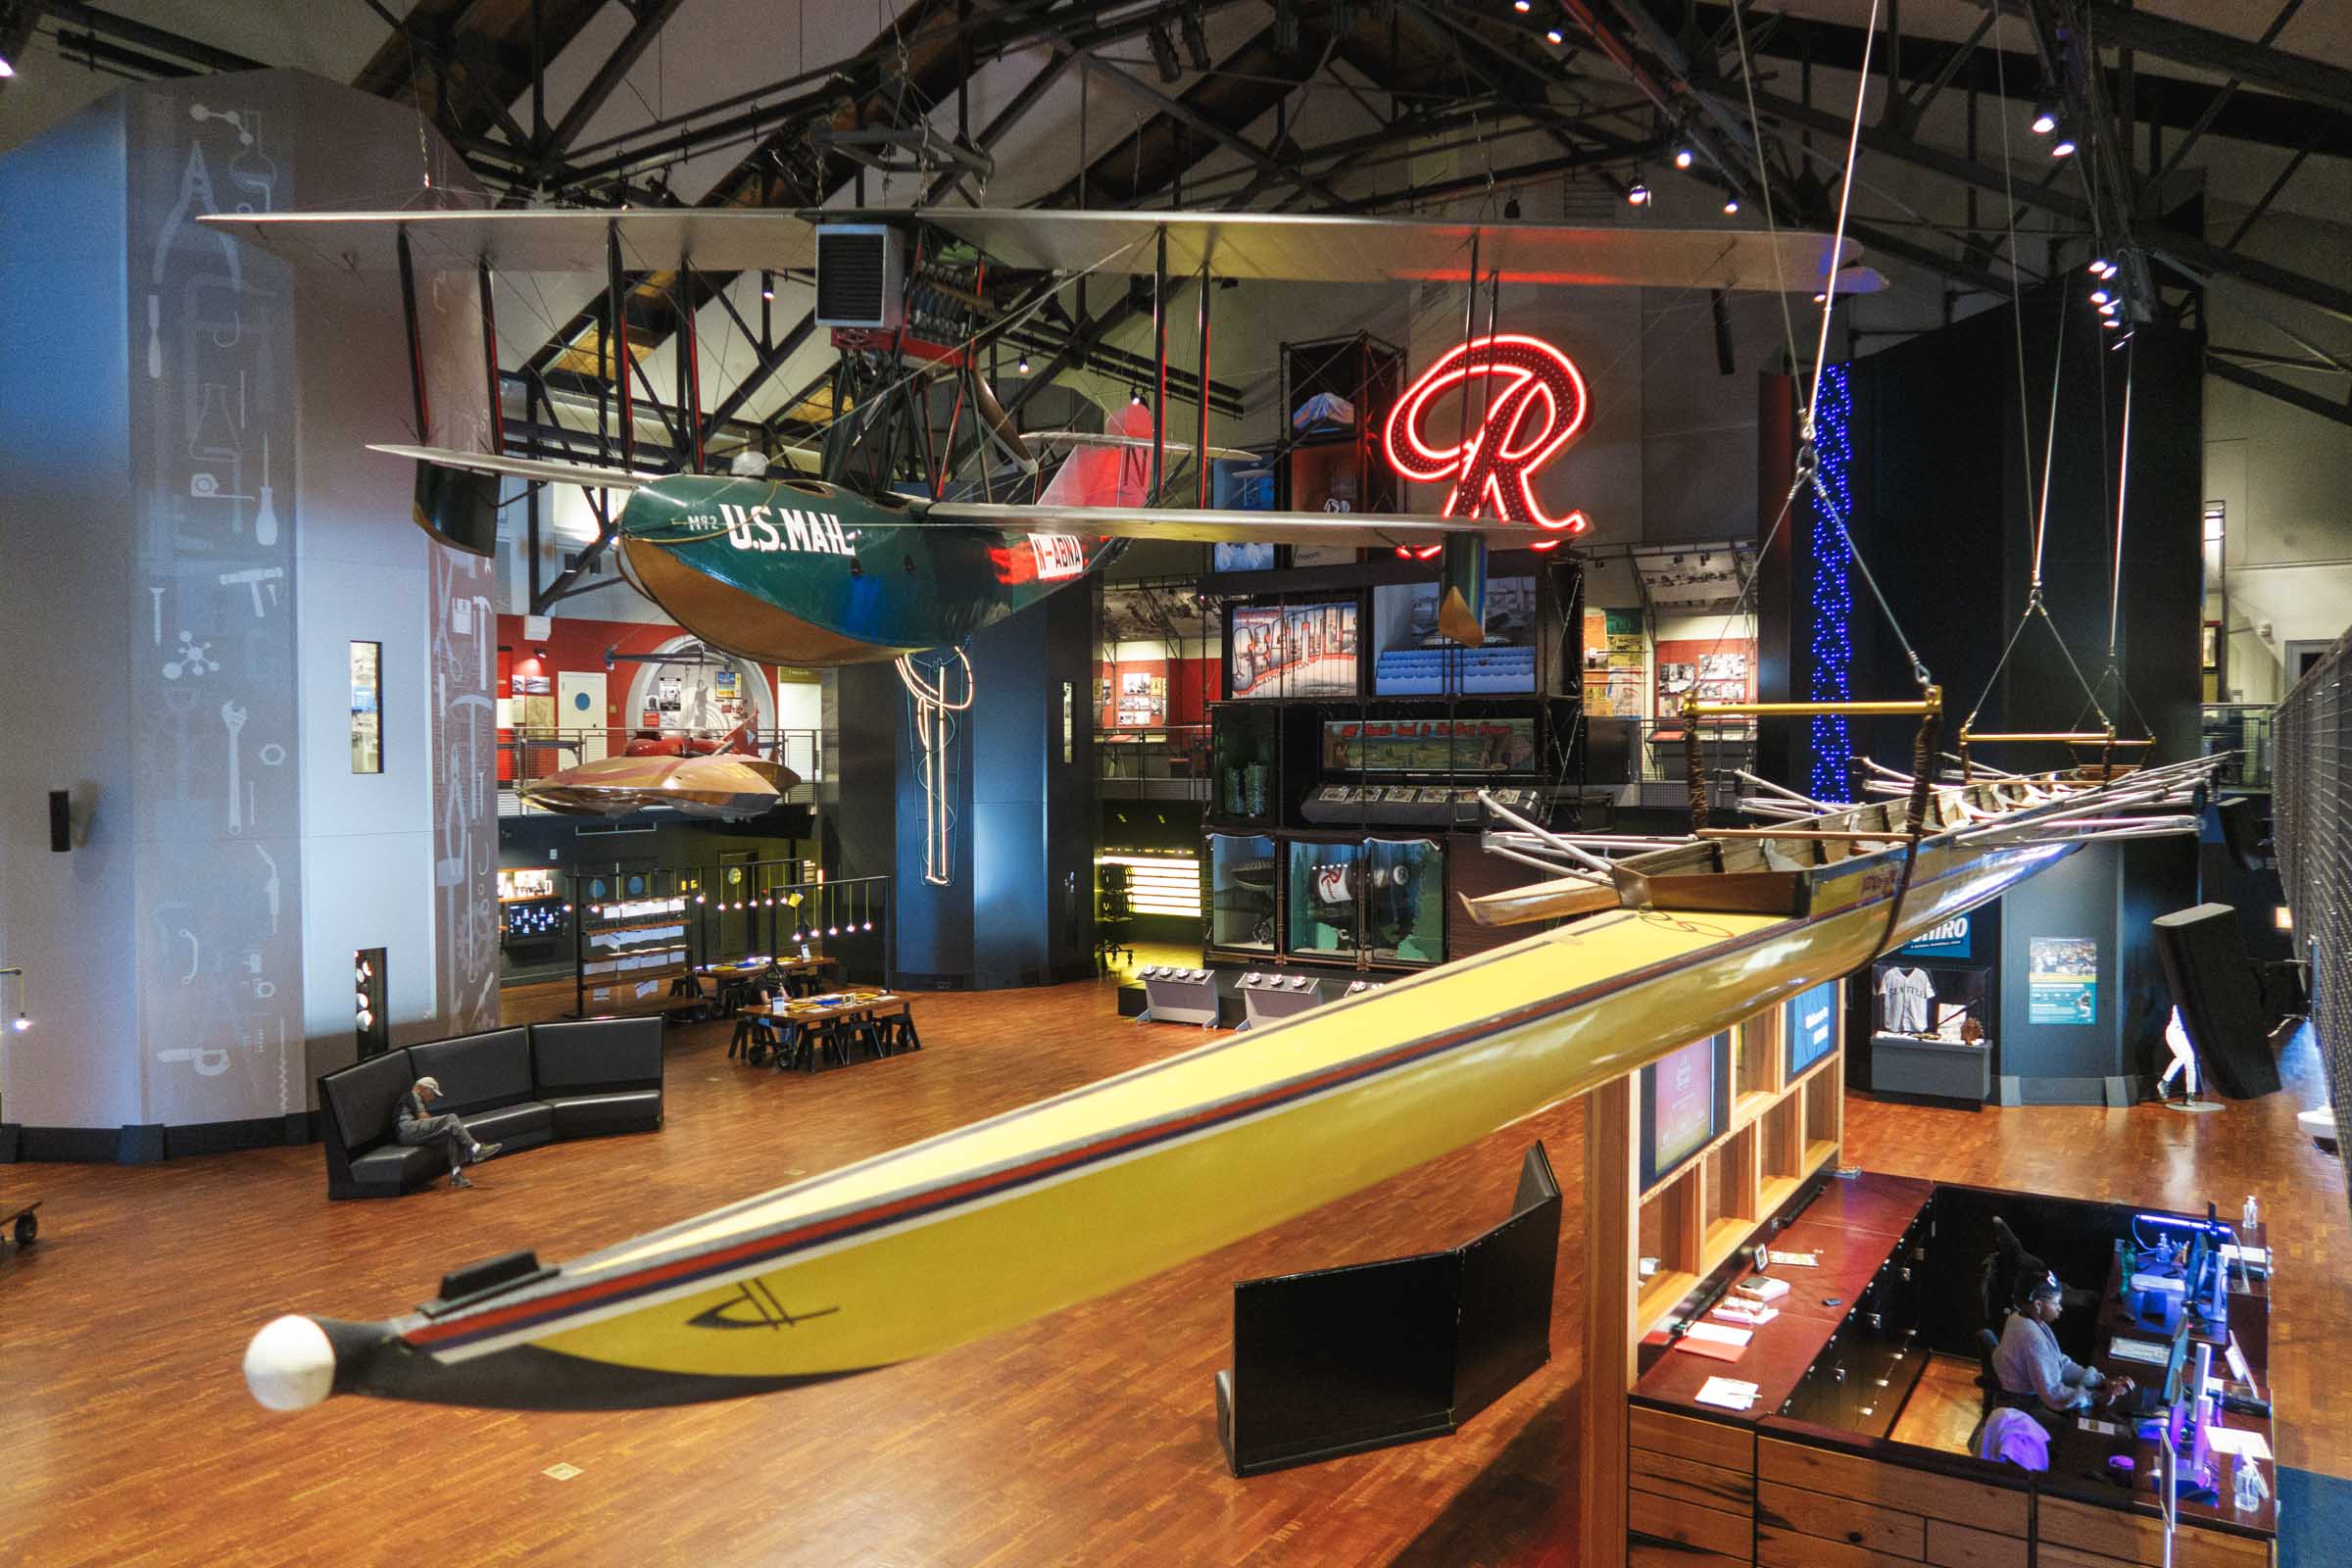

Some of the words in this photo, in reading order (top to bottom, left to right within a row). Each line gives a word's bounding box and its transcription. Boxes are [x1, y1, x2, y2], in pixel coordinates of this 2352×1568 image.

[1384, 332, 1588, 560] R
[687, 514, 719, 531] M92
[1034, 534, 1082, 571] N-ABNA
[1233, 605, 1356, 696] SEATTLE
[1254, 662, 1310, 688] WASHIGON
